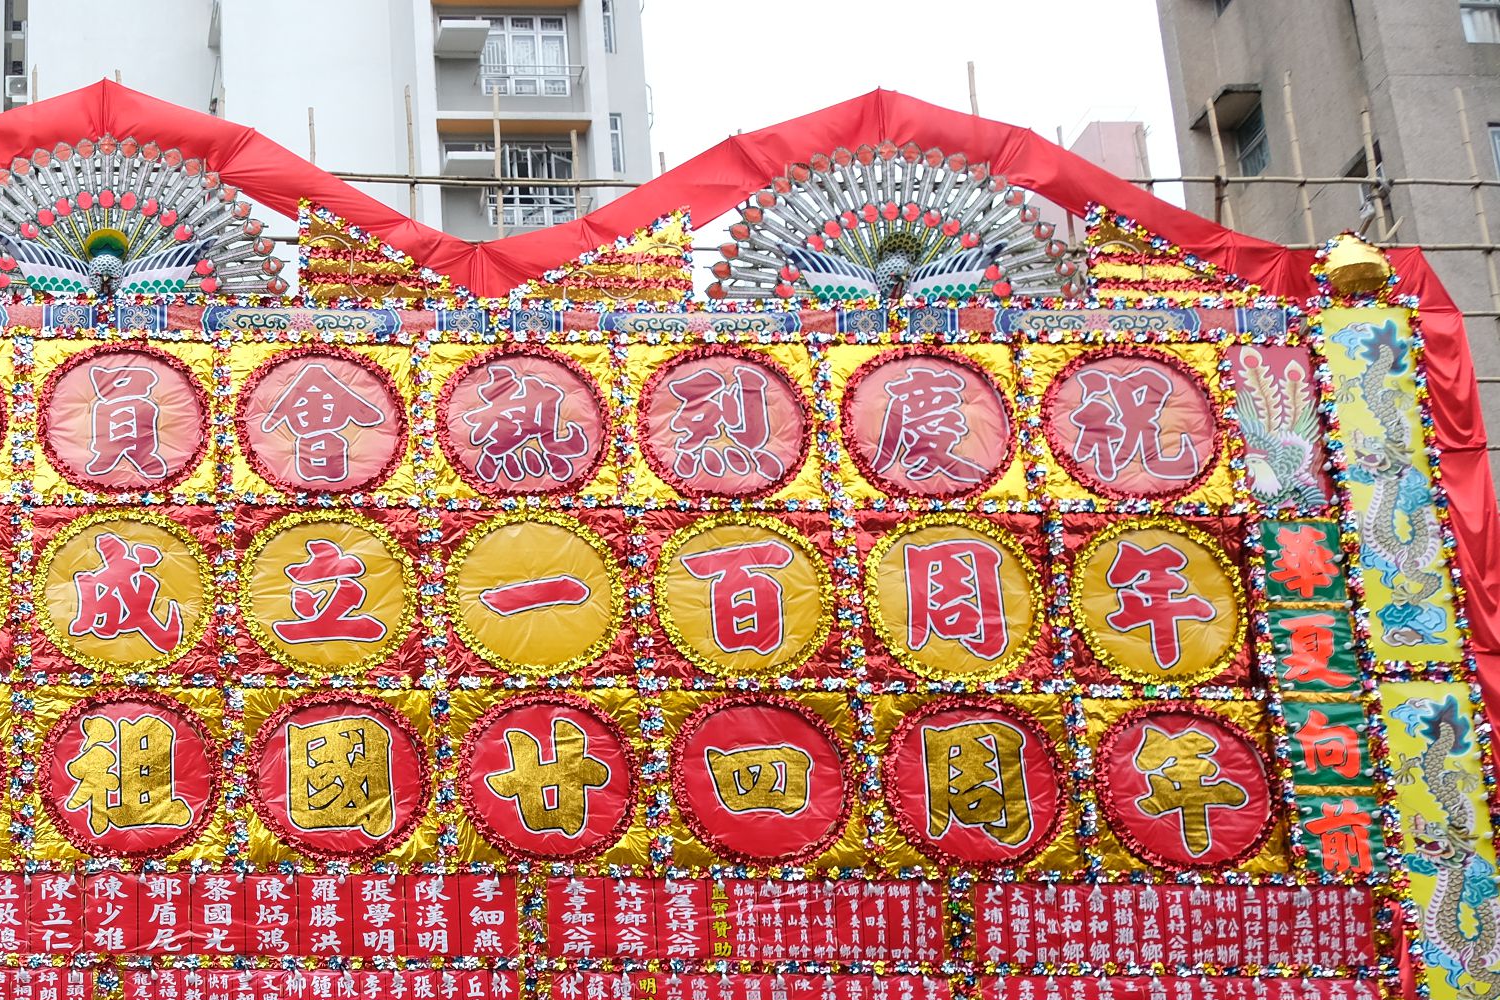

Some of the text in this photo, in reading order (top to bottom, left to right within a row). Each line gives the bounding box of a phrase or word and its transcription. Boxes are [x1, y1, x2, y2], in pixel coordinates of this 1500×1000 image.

[1269, 525, 1374, 874] 華夏向前
[41, 878, 76, 951] 陳立仁
[93, 878, 128, 951] 陳少雄
[203, 878, 236, 952] 黎國光
[256, 879, 290, 952] 陳炳鴻
[309, 879, 344, 953] 羅勝洪
[361, 879, 399, 953] 張學明
[415, 879, 450, 953] 陳漢明
[613, 882, 648, 956] 林村鄉公所
